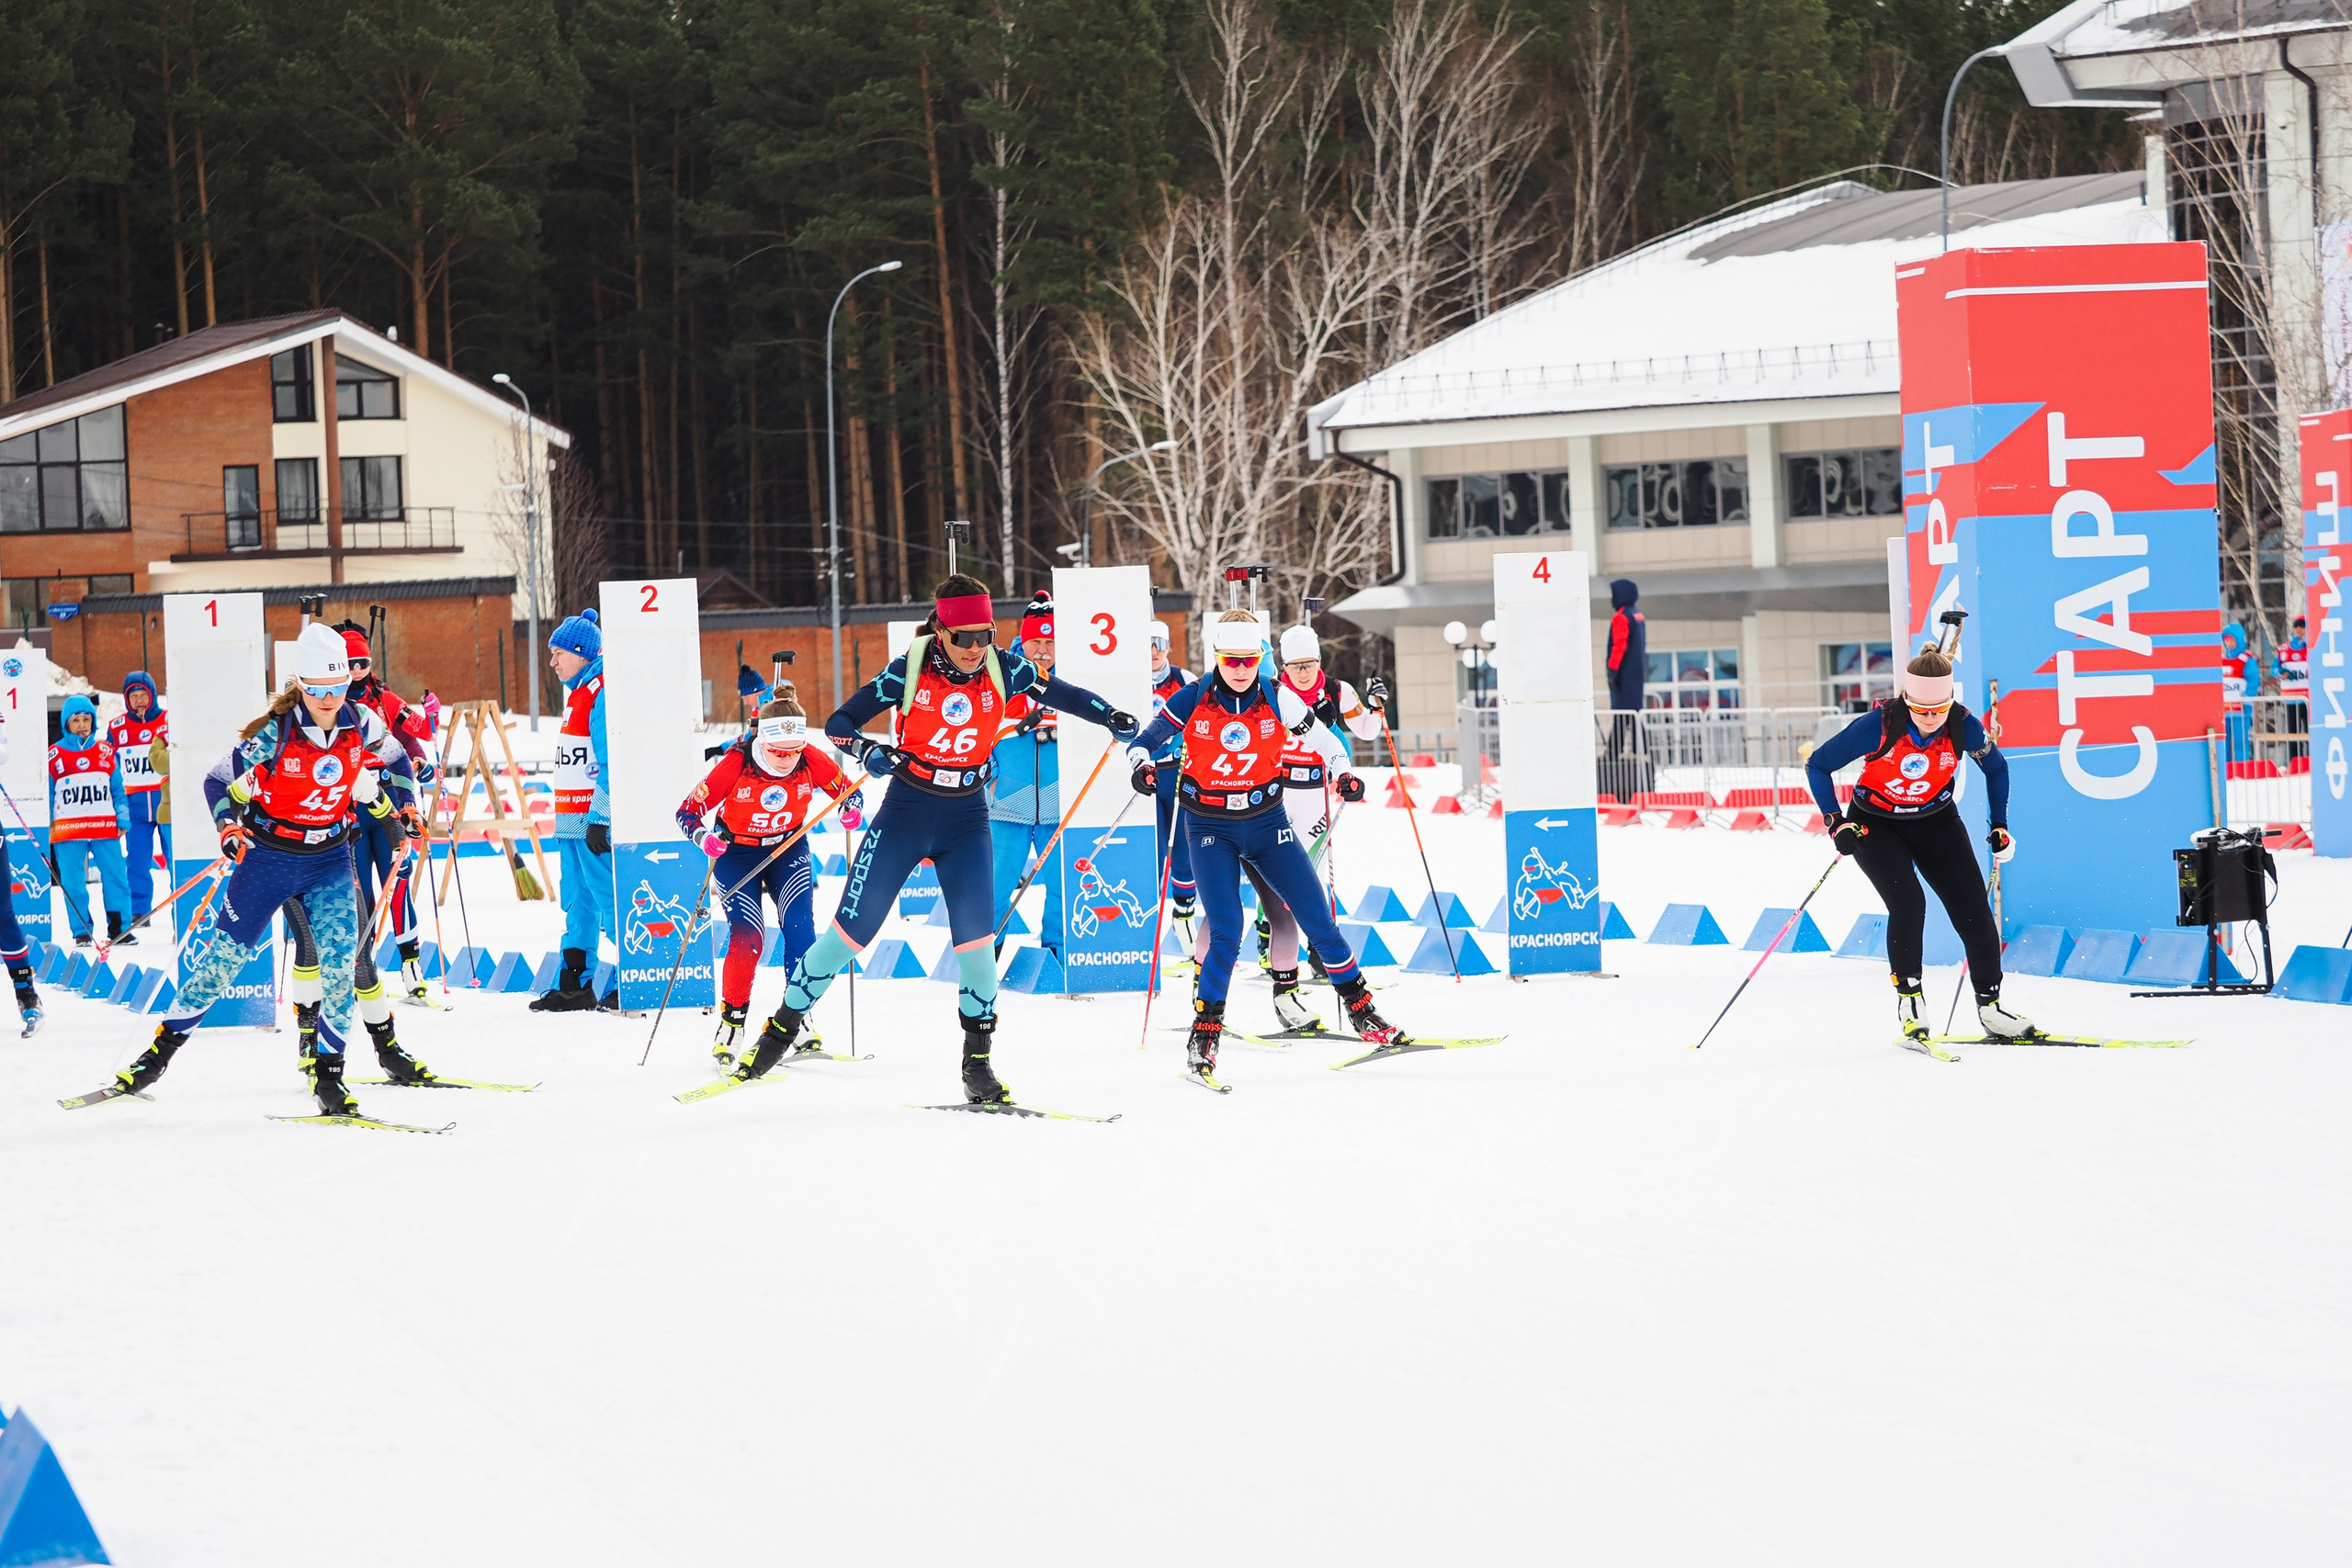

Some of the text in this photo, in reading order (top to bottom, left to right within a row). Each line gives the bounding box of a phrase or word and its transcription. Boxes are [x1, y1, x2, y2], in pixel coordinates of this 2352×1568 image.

[1532, 557, 1552, 583] 4
[640, 585, 659, 613] 2
[2047, 412, 2157, 800] СТАРТ
[204, 599, 219, 627] 1
[1090, 612, 1117, 656] 3
[2315, 470, 2348, 800] ФИНИШ
[6, 687, 17, 710] 1
[927, 727, 978, 755] 46
[124, 756, 154, 775] СУД
[555, 745, 588, 769] ДЬЯ
[1211, 752, 1259, 777] 47
[1210, 779, 1255, 787] КРАСНОЯРСК
[1883, 777, 1931, 796] 49
[62, 784, 109, 807] СУДЬЯ
[299, 784, 348, 812] 45
[106, 819, 117, 829] КРА
[749, 811, 794, 829] 50
[13, 913, 51, 925] ОЯРСК
[1510, 931, 1600, 949] КРАСНОЯРСК
[620, 965, 713, 984] КРАСНОЯРСК
[221, 984, 273, 999] ОЯРСК
[978, 1022, 991, 1031] 196
[330, 1116, 354, 1126] FISCHER
